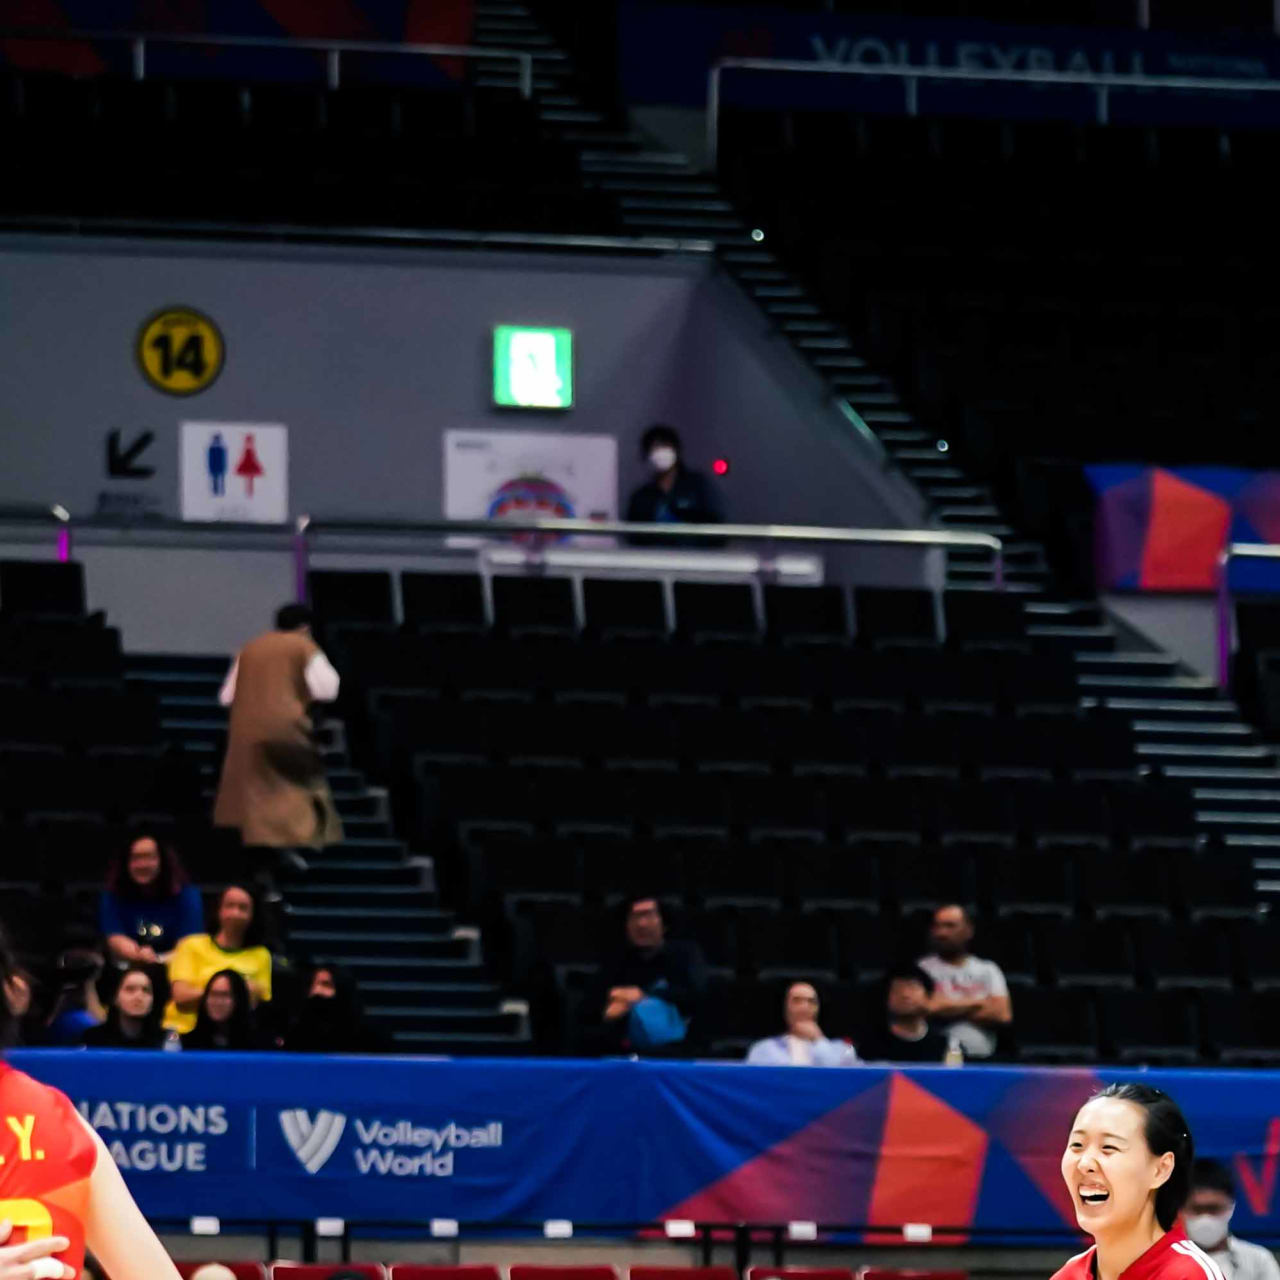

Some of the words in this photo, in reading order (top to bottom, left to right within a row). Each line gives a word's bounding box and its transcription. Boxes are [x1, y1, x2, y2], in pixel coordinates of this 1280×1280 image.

[154, 333, 206, 377] 14
[354, 1118, 503, 1152] Volleyball
[111, 1142, 207, 1171] AGUE
[354, 1149, 454, 1176] World
